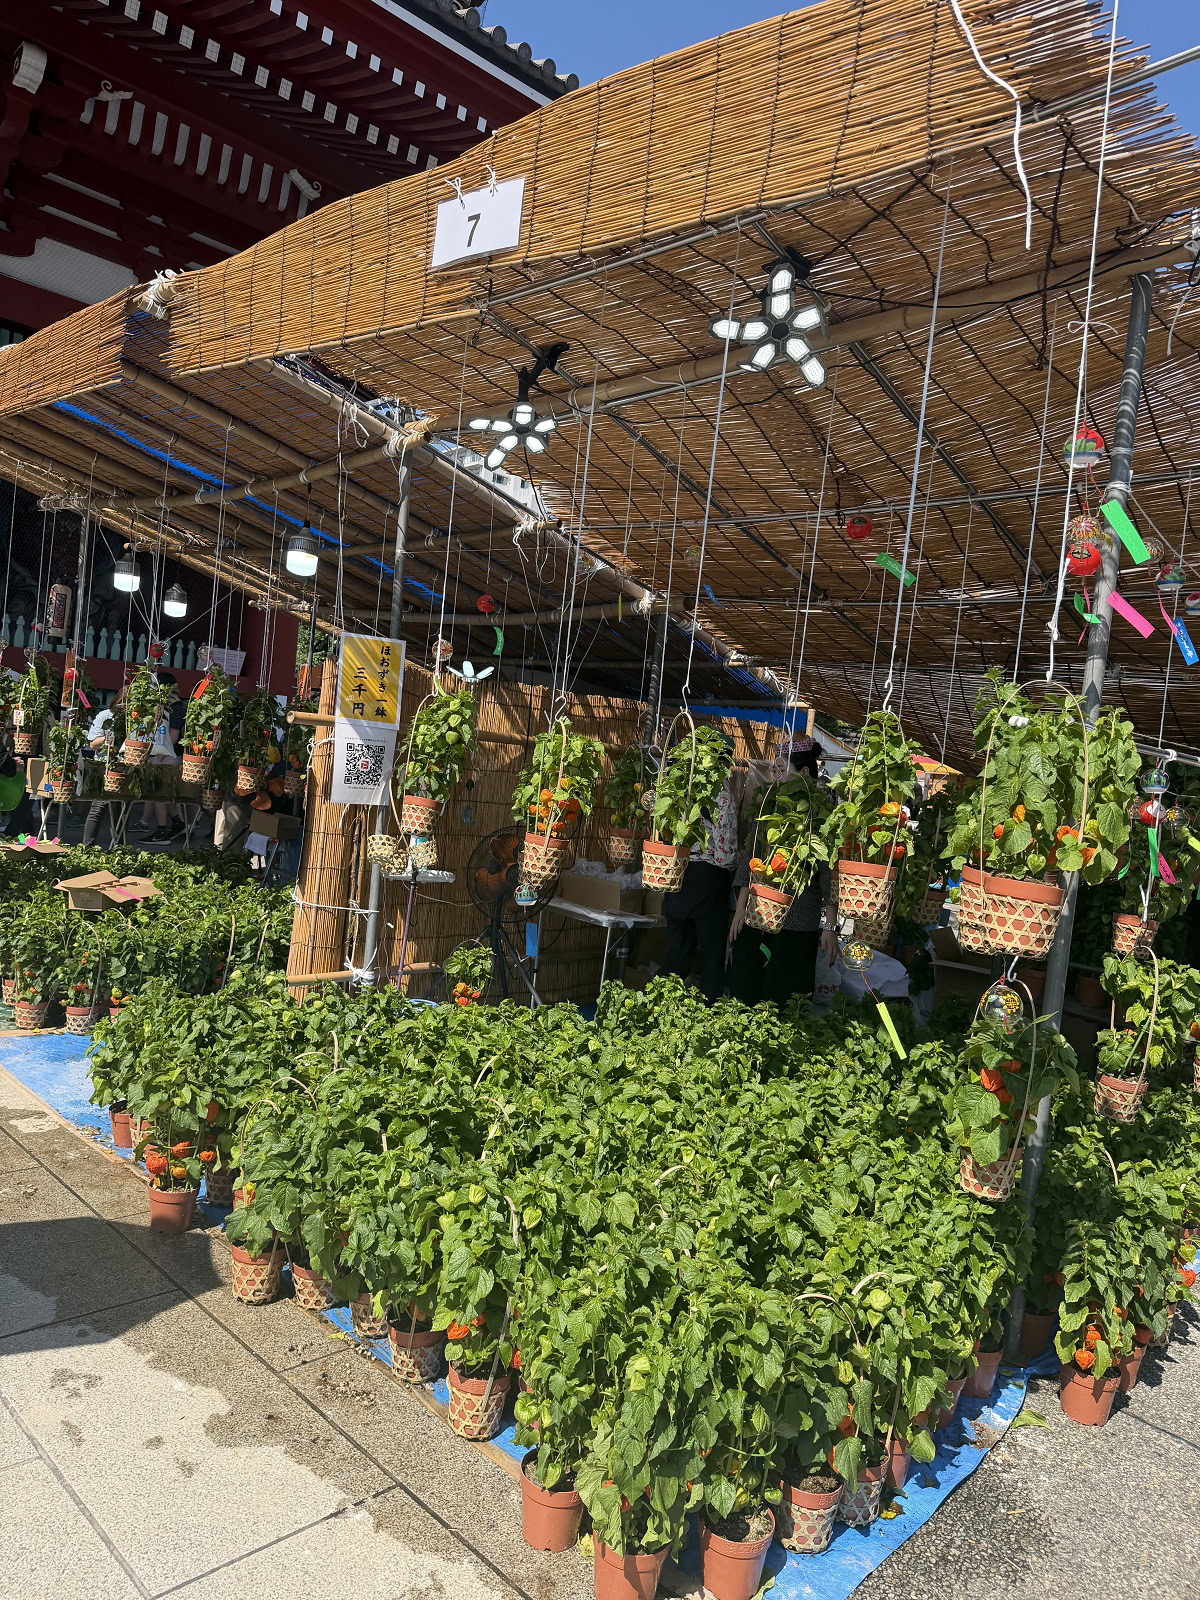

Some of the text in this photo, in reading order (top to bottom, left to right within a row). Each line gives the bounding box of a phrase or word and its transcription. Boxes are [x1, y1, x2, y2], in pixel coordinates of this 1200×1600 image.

[466, 213, 481, 248] 7
[351, 666, 368, 717] 三千円
[374, 645, 392, 719] ほおずき一鉢
